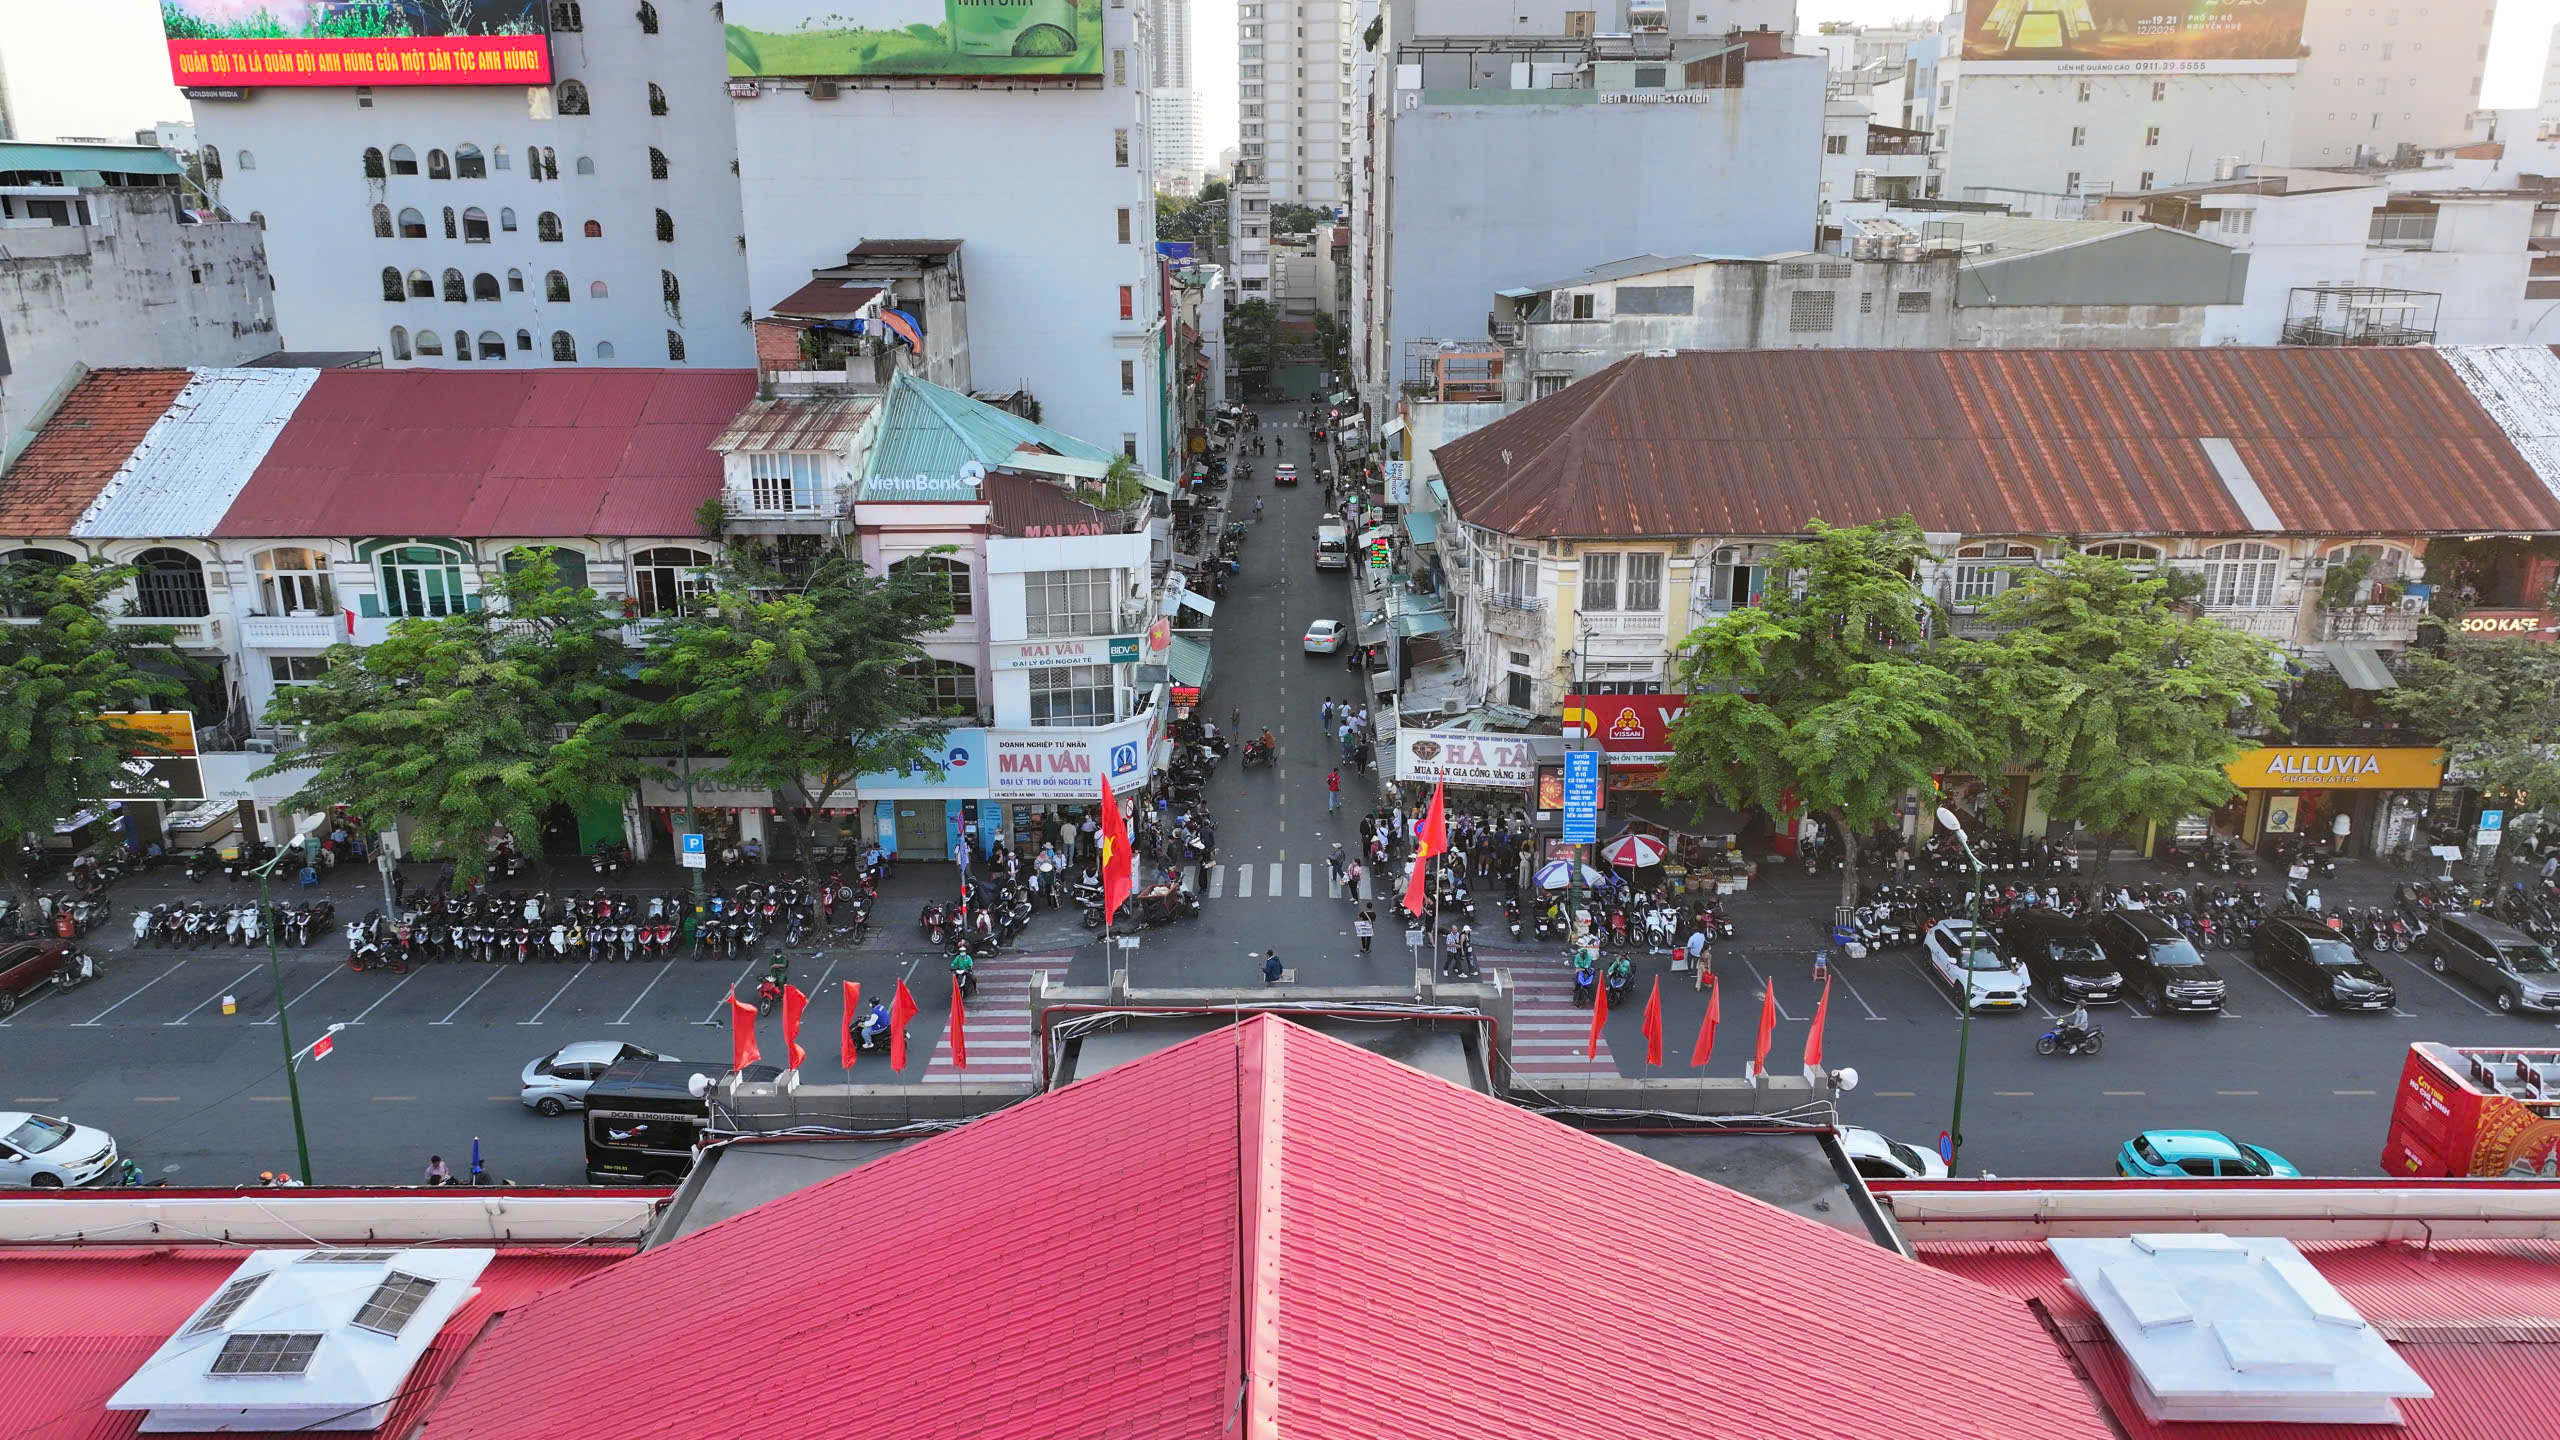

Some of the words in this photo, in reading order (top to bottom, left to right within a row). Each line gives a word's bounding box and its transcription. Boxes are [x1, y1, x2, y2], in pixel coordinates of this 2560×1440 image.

[2136, 25, 2176, 36] 12/2025
[179, 50, 209, 73] QUÂN
[211, 50, 231, 76] ĐỘI
[232, 54, 247, 72] TA
[250, 51, 262, 72] LÀ
[264, 50, 294, 72] QUÂN
[296, 50, 316, 76] ĐỘI
[318, 54, 341, 72] ANH
[343, 50, 373, 72] HÙNG
[376, 48, 399, 71] CỦA
[400, 49, 426, 75] MỘT
[428, 48, 451, 71] DÂN
[454, 48, 476, 74] TỘC
[478, 52, 502, 71] ANH
[503, 48, 539, 70] HÙNG!
[2057, 63, 2074, 71] LIÊN
[2075, 64, 2085, 73] HỆ
[2086, 63, 2113, 71] QUẢNG
[2114, 63, 2130, 71] CÁO
[2135, 62, 2206, 70] 0911.39.5555
[866, 474, 962, 491] VietinBank
[1025, 524, 1063, 537] MAI
[1067, 520, 1105, 536] VÂN
[1021, 645, 1050, 657] MAI
[1055, 640, 1085, 655] VÂN
[1110, 645, 1131, 654] BIDV
[1026, 741, 1053, 749] NGHIỆP
[1446, 741, 1487, 767] HÀ
[999, 753, 1042, 773] MAI
[1048, 750, 1091, 773] VÂN
[2266, 753, 2379, 774] ALLUVIA
[1414, 766, 1432, 774] MUA
[1453, 767, 1467, 776] GIA
[1469, 767, 1491, 777] CÔNG
[1493, 768, 1514, 779] VÀNG
[1000, 778, 1014, 787] ĐẠI
[1015, 777, 1024, 785] LÝ
[1026, 778, 1041, 786] THU
[1043, 776, 1057, 786] ĐỔI
[1058, 778, 1081, 786] NGOẠI
[2282, 775, 2360, 783] CHOCOLATIER
[2488, 815, 2499, 825] P
[690, 838, 699, 849] P
[611, 1111, 634, 1119] DCAR
[637, 1113, 686, 1121] LIMOUSINE
